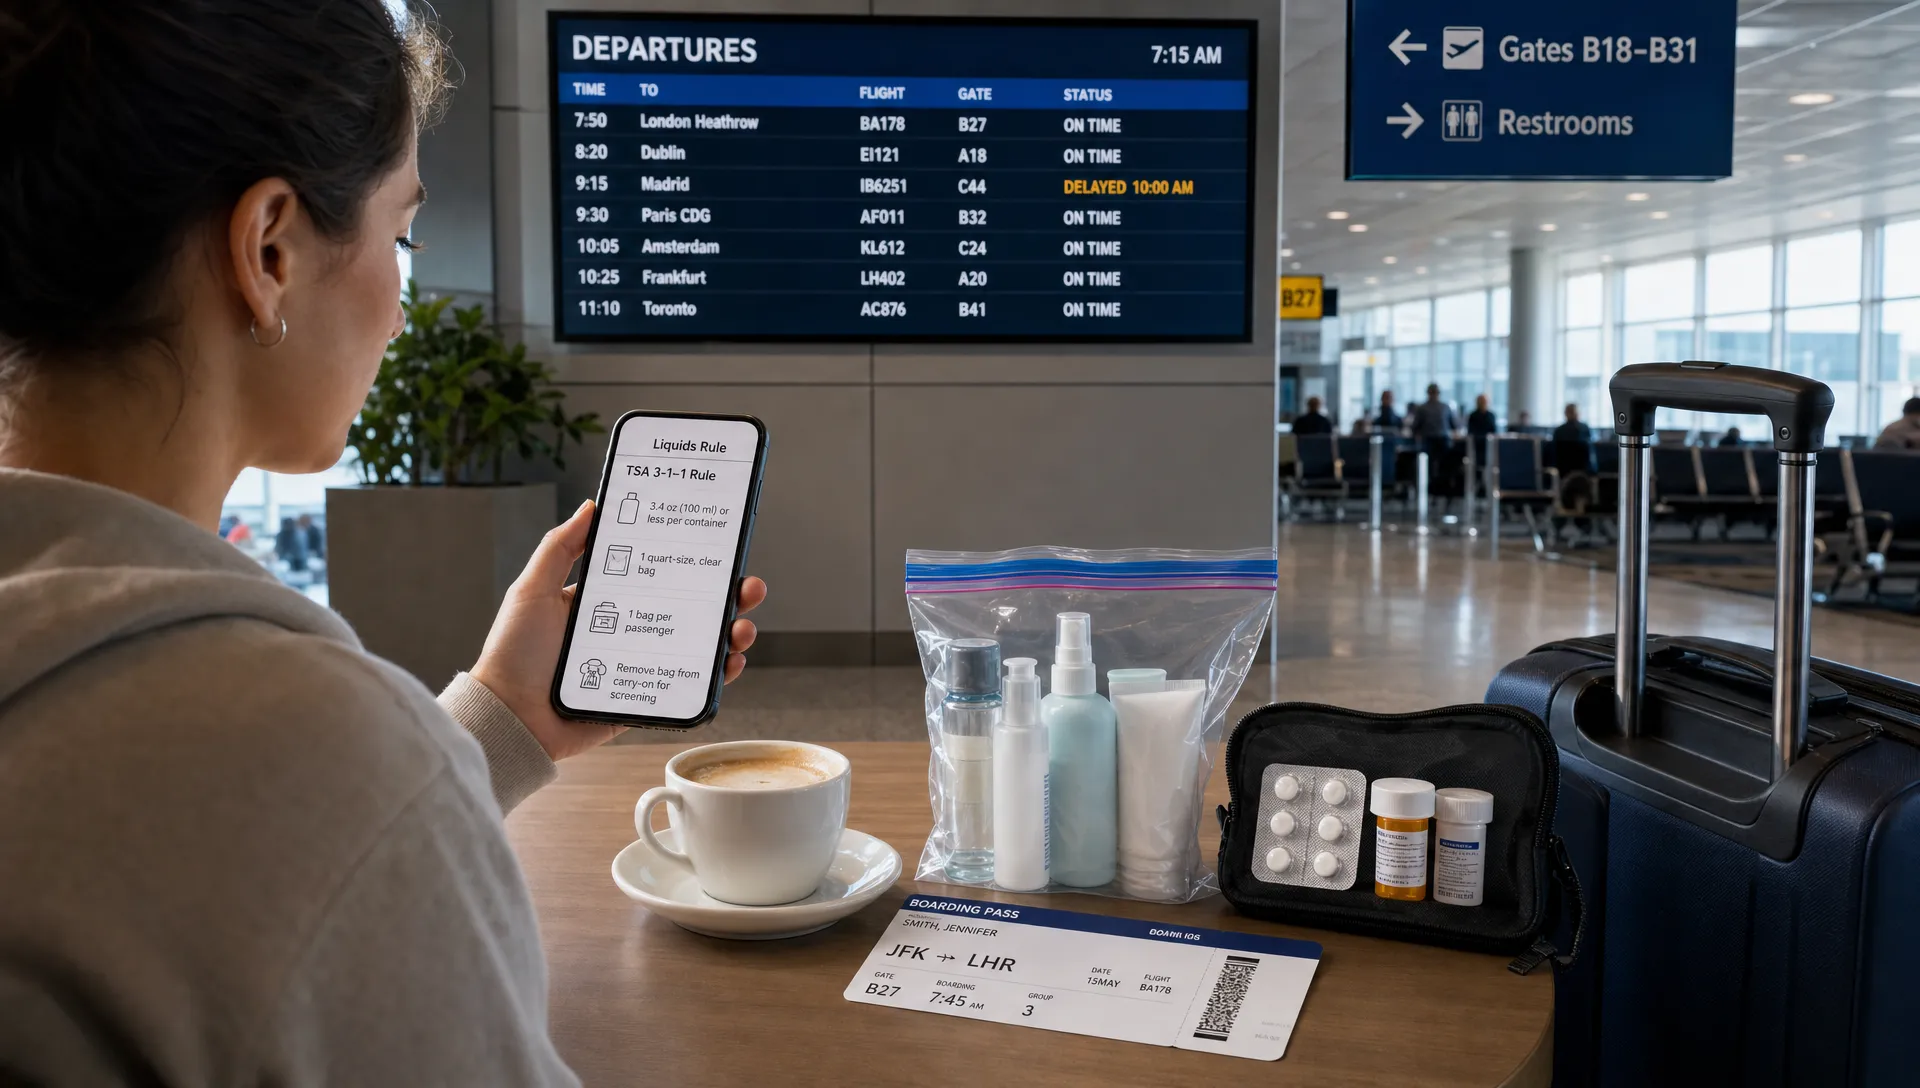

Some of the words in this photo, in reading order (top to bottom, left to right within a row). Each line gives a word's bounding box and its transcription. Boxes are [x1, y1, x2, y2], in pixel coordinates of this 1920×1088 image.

[572, 34, 758, 63] DEPARTURES
[1151, 45, 1190, 64] 7:15
[1194, 46, 1222, 64] AM
[1499, 35, 1574, 62] Gates
[573, 82, 606, 96] TIME
[639, 83, 658, 96] TO
[860, 86, 905, 99] FLIGHT
[958, 87, 992, 100] GATE
[1064, 88, 1112, 101] STATUS
[574, 112, 607, 128] 7:50
[640, 114, 691, 129] London
[695, 114, 759, 130] Heathrow
[860, 116, 905, 131] BA178
[959, 117, 987, 132] B27
[1063, 119, 1084, 134] ON
[1087, 119, 1121, 134] TIME
[1499, 109, 1633, 135] Restrooms
[575, 144, 608, 160] 8:20
[641, 144, 685, 160] Dublin
[860, 147, 899, 162] EI121
[958, 148, 987, 163] A18
[1063, 149, 1084, 164] ON
[1087, 149, 1121, 164] TIME
[575, 175, 608, 191] 9:15
[641, 176, 690, 192] Madrid
[860, 178, 907, 193] IB6251
[958, 179, 986, 194] C44
[1064, 180, 1127, 194] DELAYED
[1132, 180, 1169, 195] 10:00
[1172, 181, 1193, 195] AM
[576, 207, 609, 223] 9:30
[642, 208, 677, 223] Paris
[680, 208, 711, 223] CDG
[860, 209, 905, 224] AF011
[959, 210, 986, 225] B32
[1063, 211, 1084, 226] ON
[1087, 211, 1121, 226] TIME
[577, 238, 620, 253] 10:05
[642, 239, 719, 254] Amsterdam
[860, 240, 905, 255] KL612
[958, 240, 986, 256] C24
[1063, 242, 1084, 256] ON
[1087, 242, 1121, 256] TIME
[578, 269, 620, 284] 10:25
[643, 269, 707, 284] Frankfurt
[860, 271, 905, 286] LH402
[958, 271, 987, 286] A20
[1063, 272, 1084, 287] ON
[1087, 272, 1121, 287] TIME
[1282, 288, 1315, 308] B27
[579, 300, 620, 316] 11:10
[643, 301, 696, 316] Toronto
[860, 301, 906, 317] AC876
[959, 302, 986, 317] B41
[1063, 302, 1084, 317] ON
[1087, 303, 1121, 317] TIME
[653, 438, 696, 452] Liquids
[700, 441, 726, 454] Rule
[626, 465, 649, 478] TSA
[690, 470, 716, 481] Rule
[650, 502, 664, 511] 3.4
[679, 504, 700, 514] (100
[702, 504, 717, 515] ml)
[647, 514, 665, 524] less
[667, 517, 682, 527] per
[684, 516, 727, 528] container
[641, 552, 645, 561] 1
[648, 553, 696, 566] quart-size,
[699, 556, 722, 567] clear
[638, 565, 655, 577] bag
[629, 609, 633, 618] 1
[636, 610, 654, 622] bag
[656, 613, 672, 624] per
[625, 624, 674, 636] passenger
[616, 663, 655, 675] Remove
[657, 666, 675, 678] bag
[678, 668, 700, 679] from
[613, 678, 654, 691] carry-on
[657, 680, 670, 690] for
[610, 690, 657, 704] screening
[909, 899, 981, 914] BOARDING
[984, 908, 1020, 919] PASS
[902, 919, 940, 931] SMITH,
[943, 924, 998, 937] JENNIFER
[886, 944, 930, 961] JFK
[967, 953, 1016, 972] LHR
[1092, 967, 1112, 975] DATE
[1144, 974, 1171, 982] FLIGHT
[1088, 977, 1121, 987] 15MAY
[1140, 984, 1171, 994] BA178
[865, 983, 901, 997] B27
[929, 992, 967, 1007] 7:45
[1022, 1005, 1034, 1016] 3
